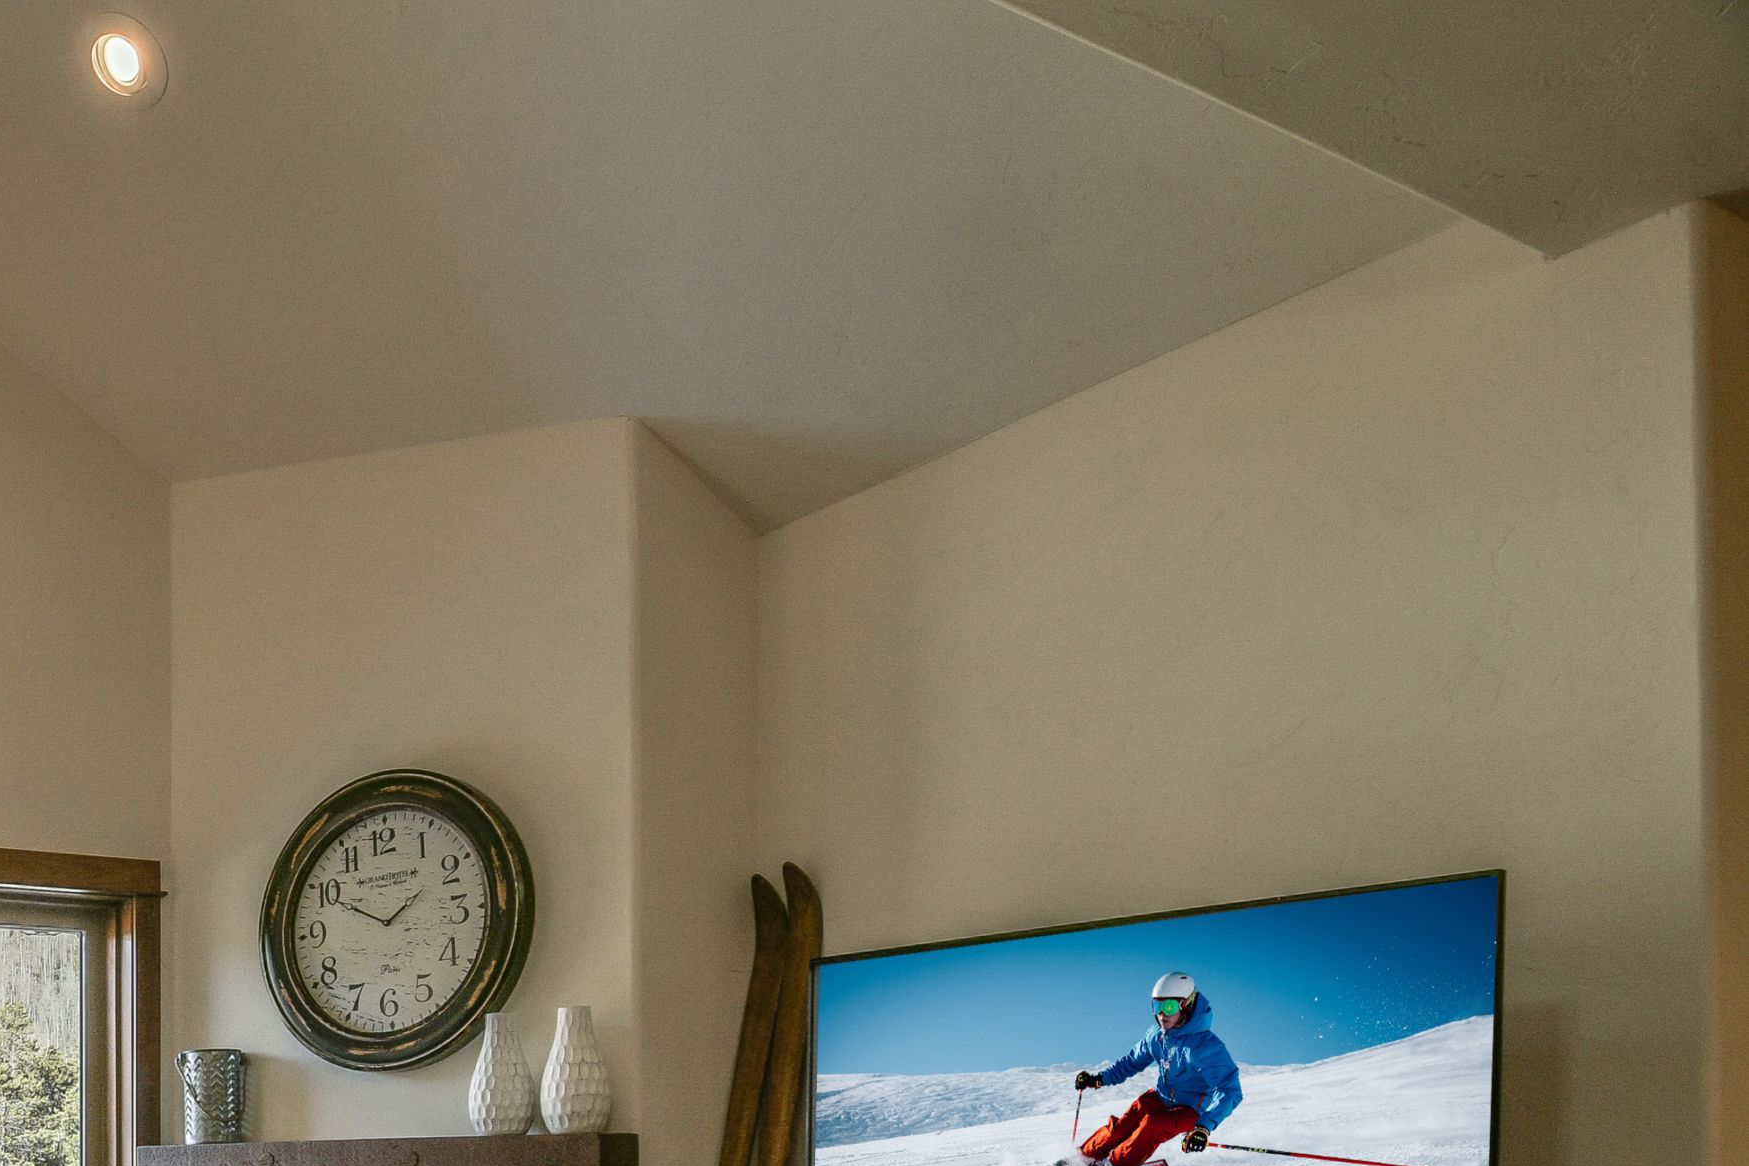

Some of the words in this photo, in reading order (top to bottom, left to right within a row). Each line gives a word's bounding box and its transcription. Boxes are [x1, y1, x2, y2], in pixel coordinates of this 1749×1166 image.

[372, 827, 397, 857] 12
[416, 832, 427, 859] 1
[343, 845, 359, 874] 11
[441, 854, 460, 885] 2
[318, 878, 341, 908] 10
[450, 893, 470, 925] 3
[309, 920, 327, 948] 9
[438, 937, 460, 967] 4
[321, 956, 338, 986] 8
[348, 982, 365, 1011] 7
[379, 988, 399, 1017] 6
[414, 973, 434, 1003] 5
